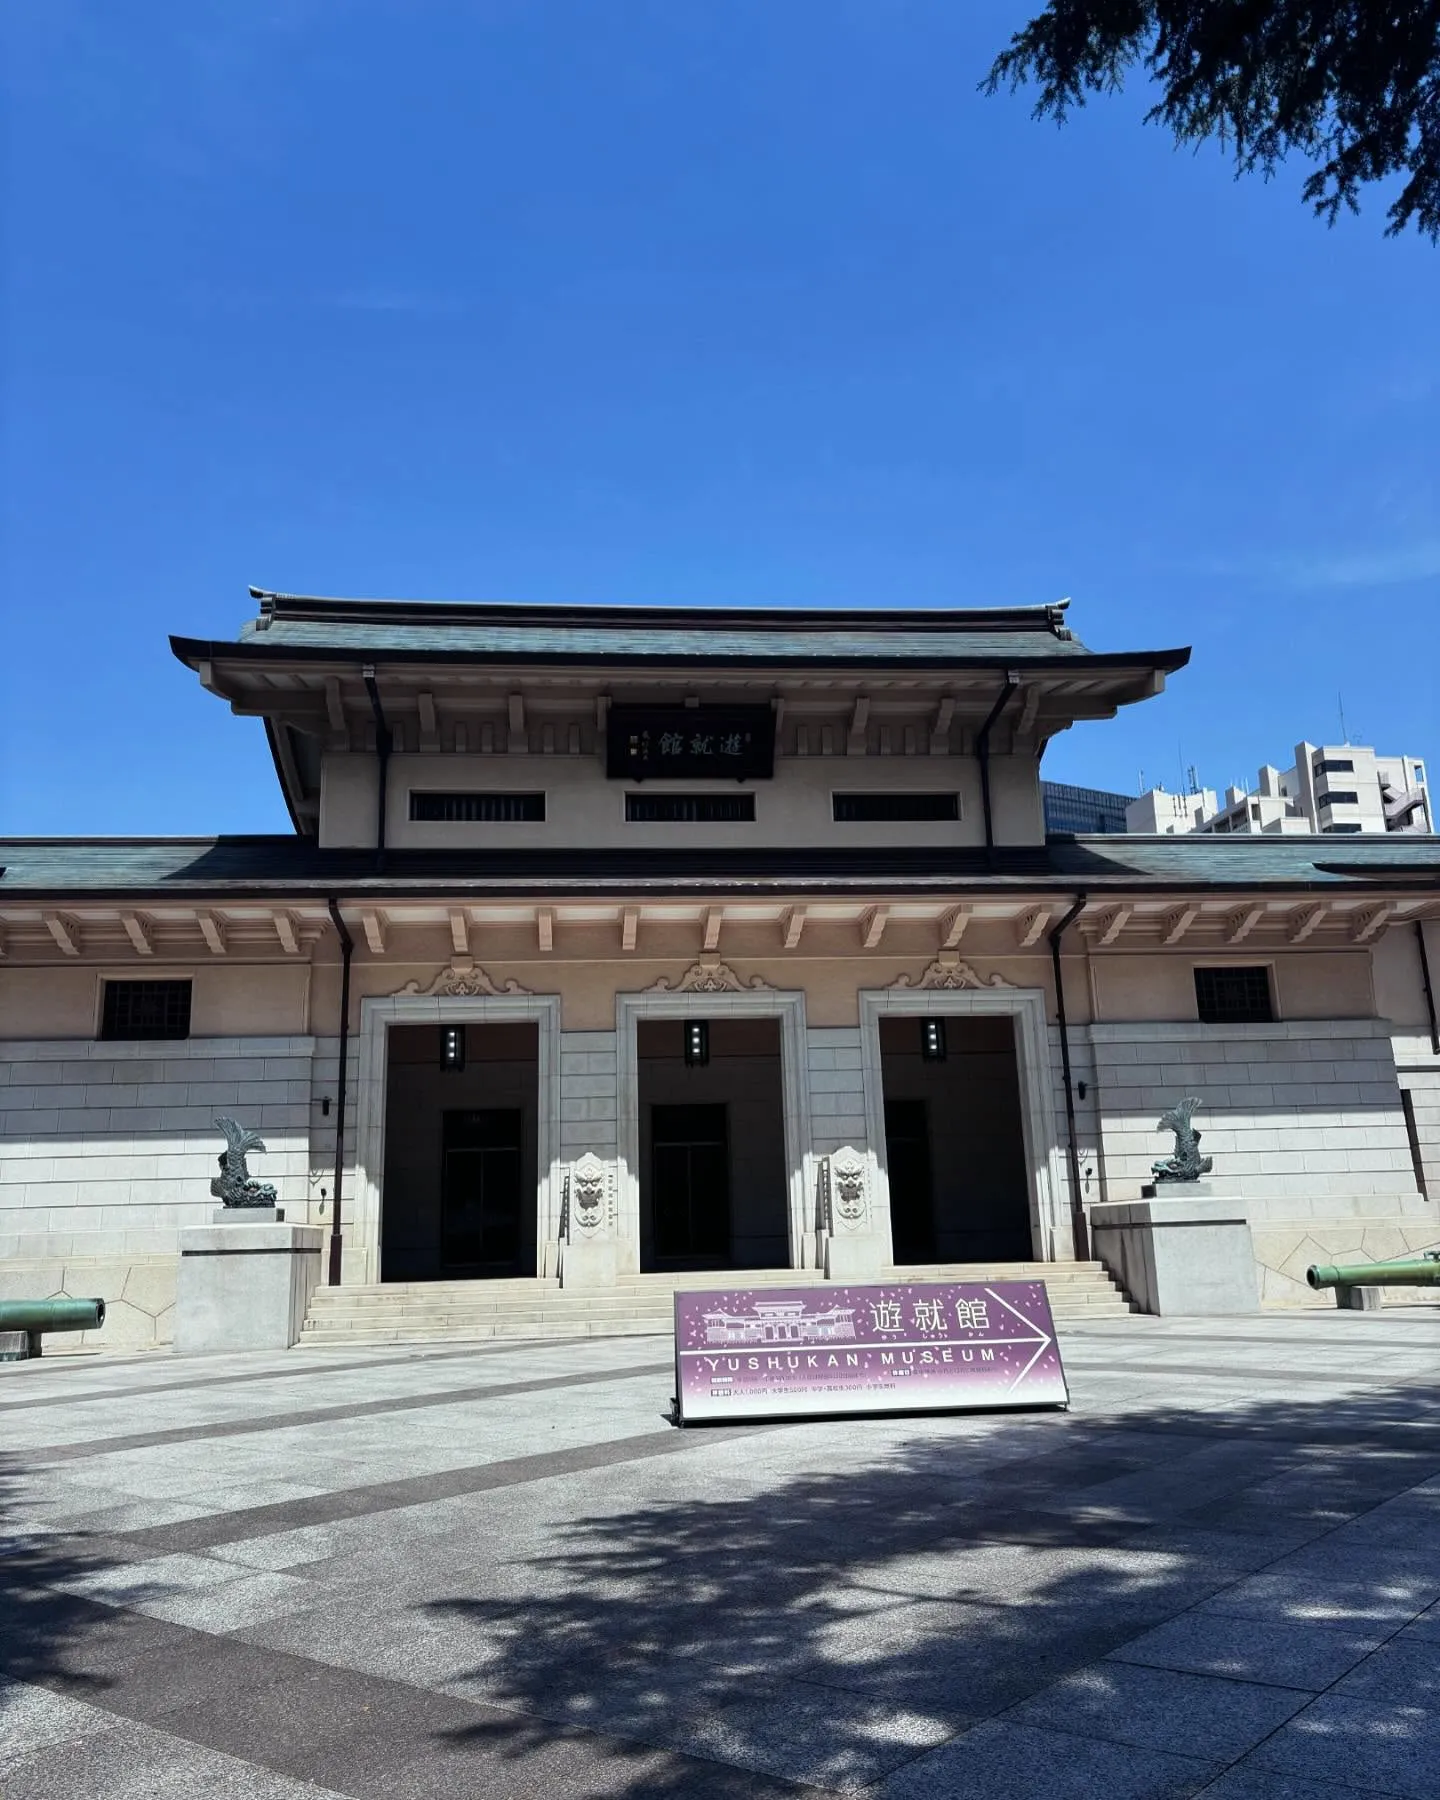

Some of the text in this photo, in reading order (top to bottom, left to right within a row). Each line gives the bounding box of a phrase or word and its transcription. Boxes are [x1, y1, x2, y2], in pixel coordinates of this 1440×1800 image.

[869, 1298, 990, 1333] 遊就館
[707, 1348, 995, 1372] YUSHUKAN MUSEUM
